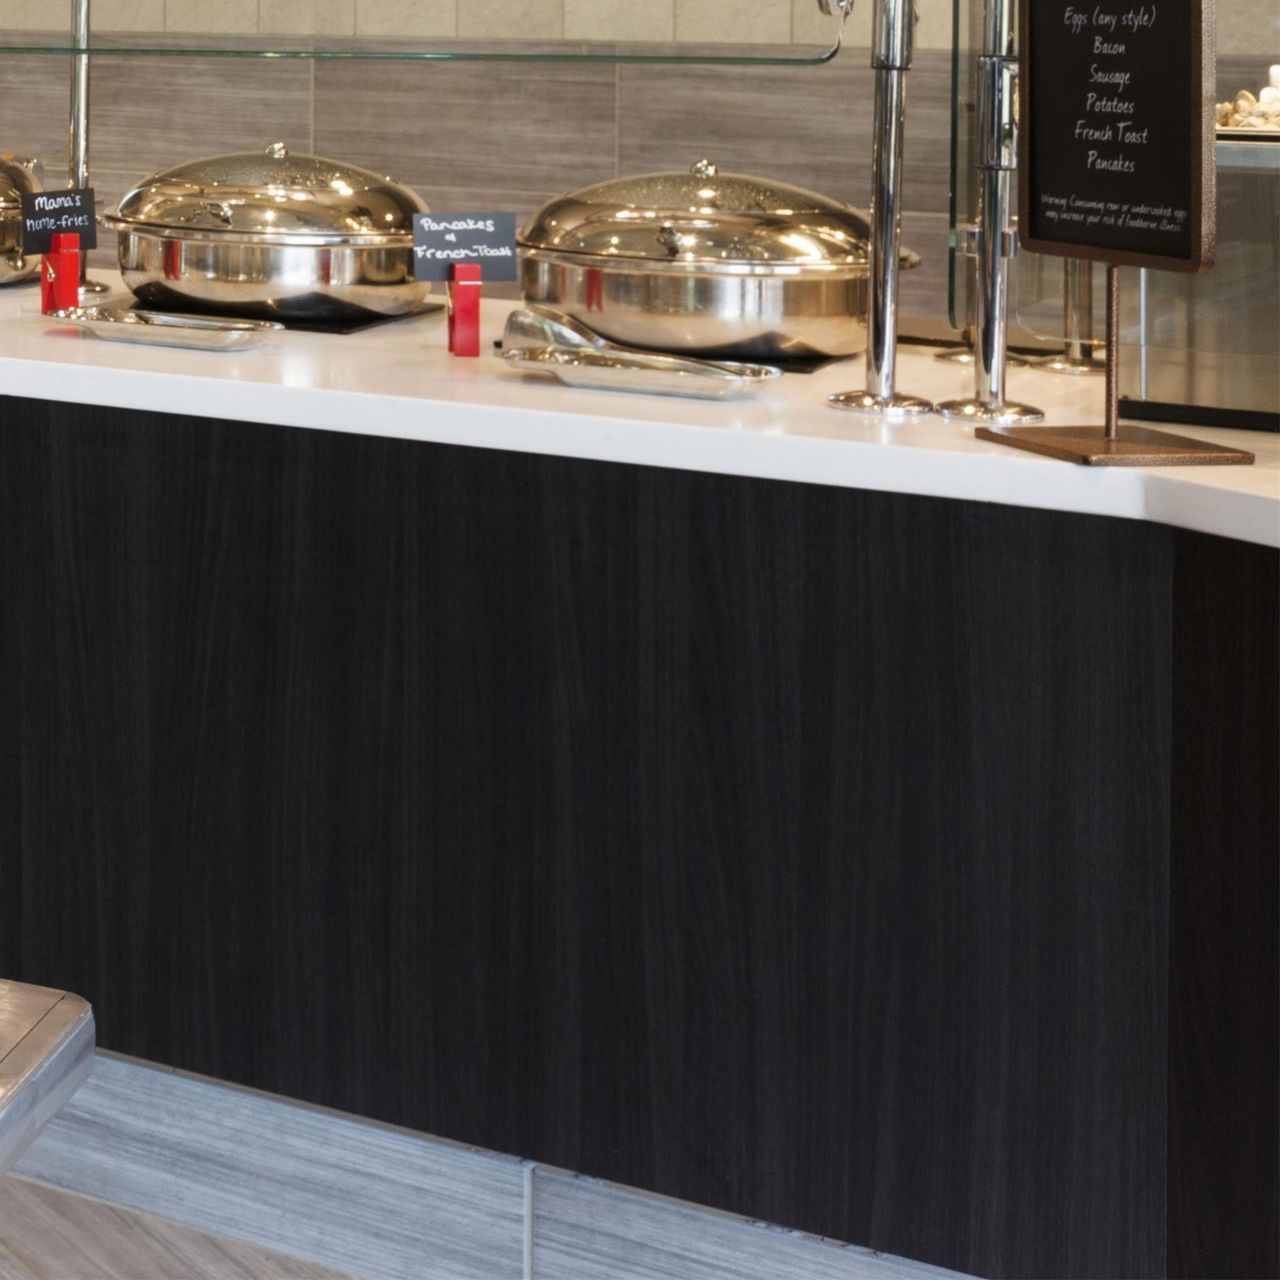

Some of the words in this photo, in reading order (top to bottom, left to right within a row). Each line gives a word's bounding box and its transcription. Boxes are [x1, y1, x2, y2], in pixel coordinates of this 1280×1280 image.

[1063, 6, 1088, 34] Eggs
[1092, 5, 1118, 33] (any
[1121, 4, 1157, 33] style)
[1093, 35, 1126, 55] Bacon
[1089, 63, 1131, 93] Sausage
[1086, 92, 1135, 114] Potatoes
[1074, 120, 1113, 141] French
[1116, 121, 1148, 144] Toast
[1087, 150, 1135, 173] Pancakes
[34, 194, 82, 212] Mama's
[420, 217, 495, 232] Pancakes
